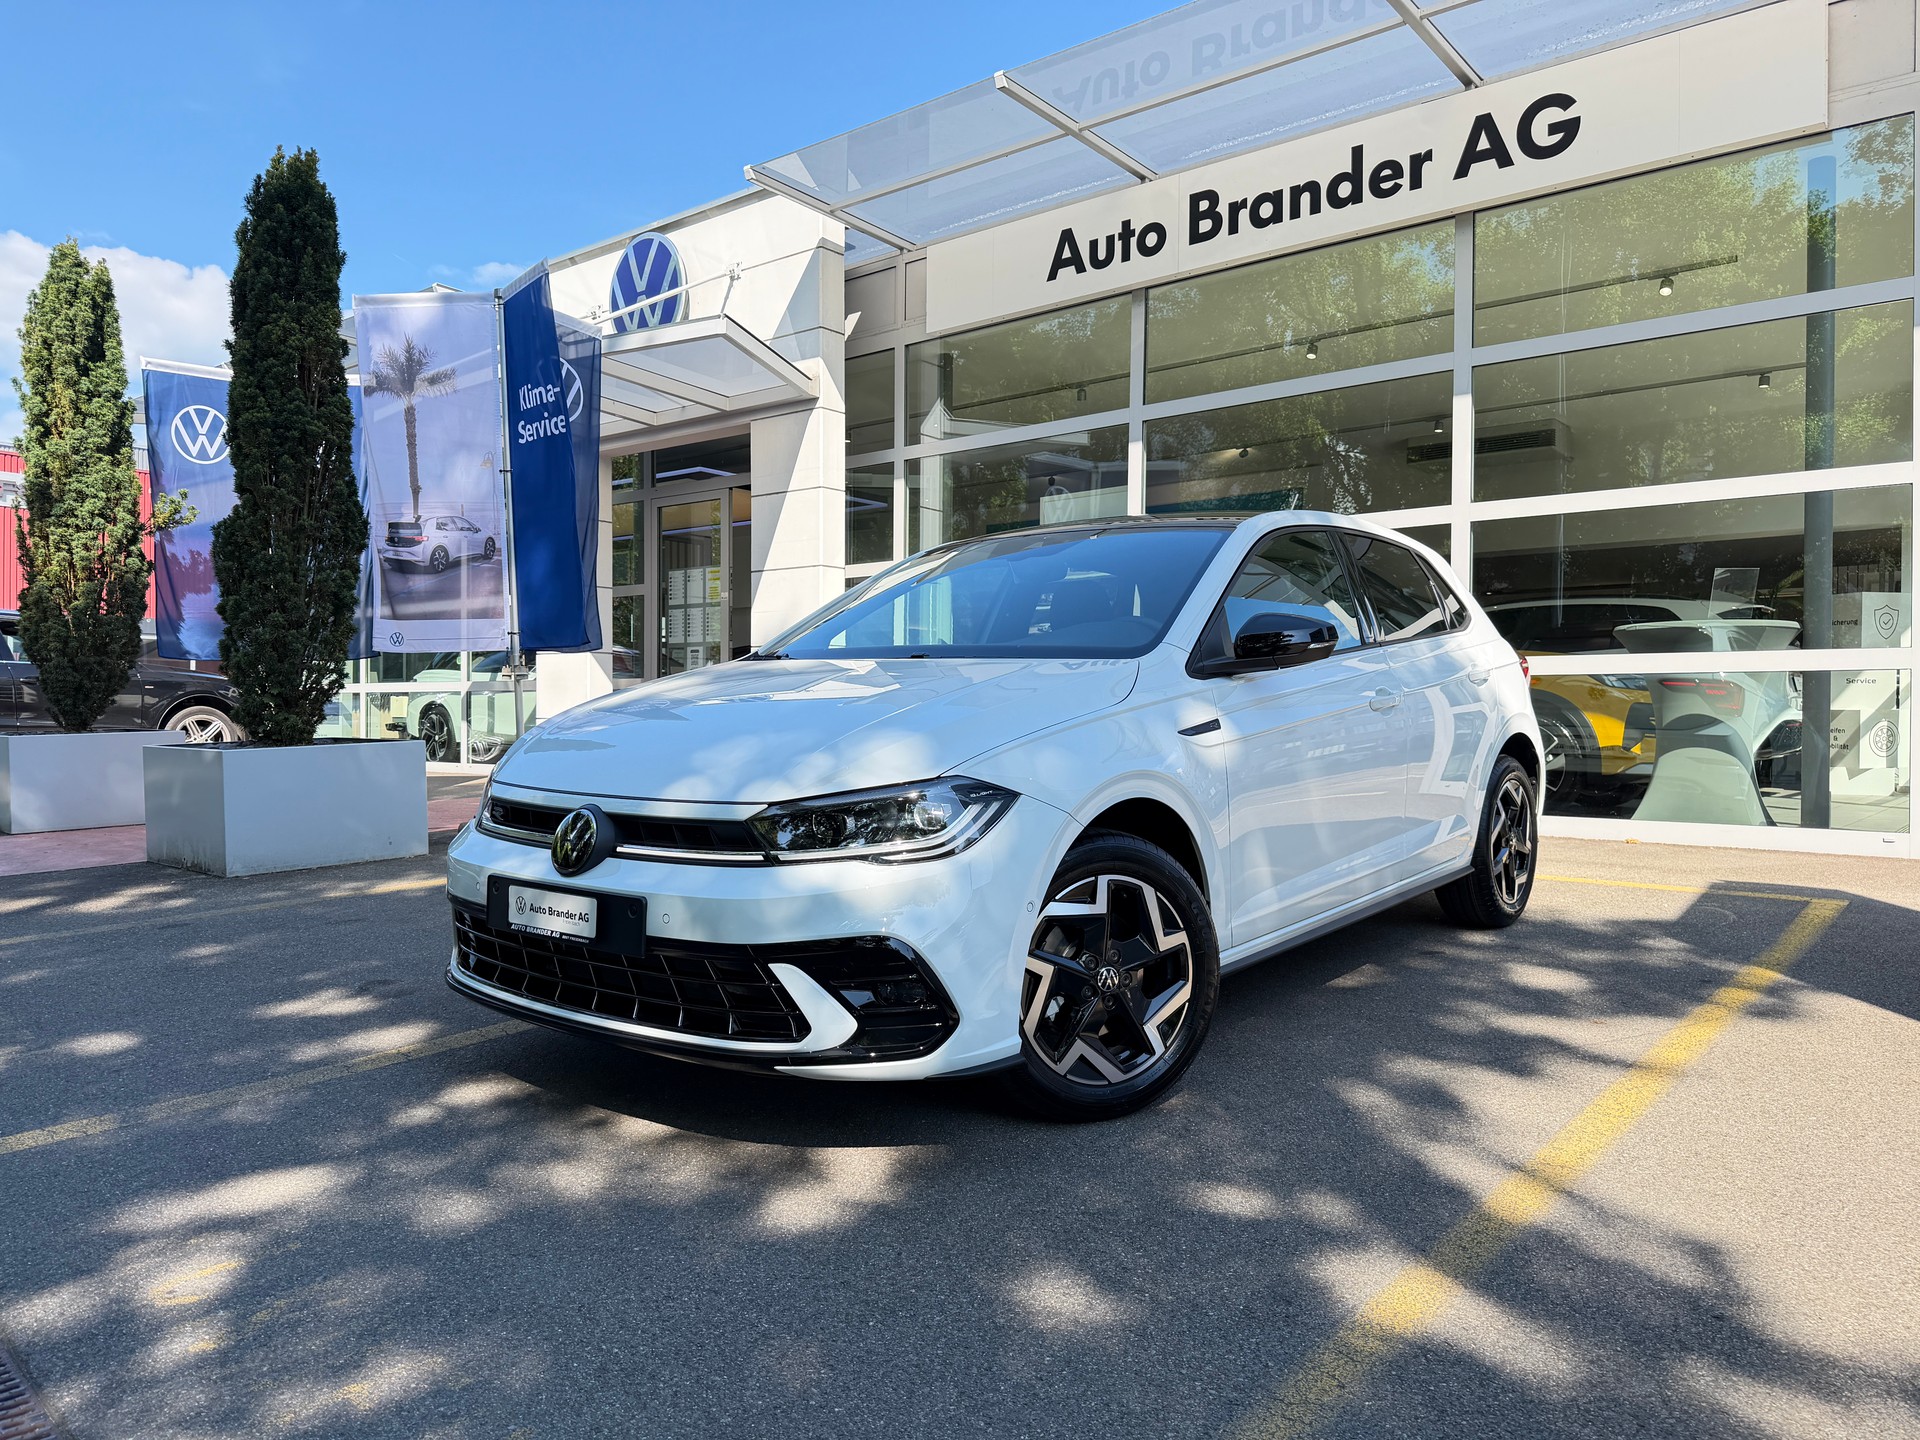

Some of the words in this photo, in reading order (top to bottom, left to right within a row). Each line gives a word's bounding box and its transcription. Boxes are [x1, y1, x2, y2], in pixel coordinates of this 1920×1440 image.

[1046, 218, 1168, 283] Auto
[1188, 143, 1433, 247] Brander
[1452, 92, 1582, 181] AG
[519, 383, 561, 412] Klima-
[517, 411, 568, 444] Service
[1845, 677, 1877, 685] Service
[529, 903, 547, 915] Auto
[548, 906, 577, 921] Brander
[578, 911, 590, 923] AG
[510, 923, 526, 932] AUTO
[526, 925, 552, 937] BRANDER
